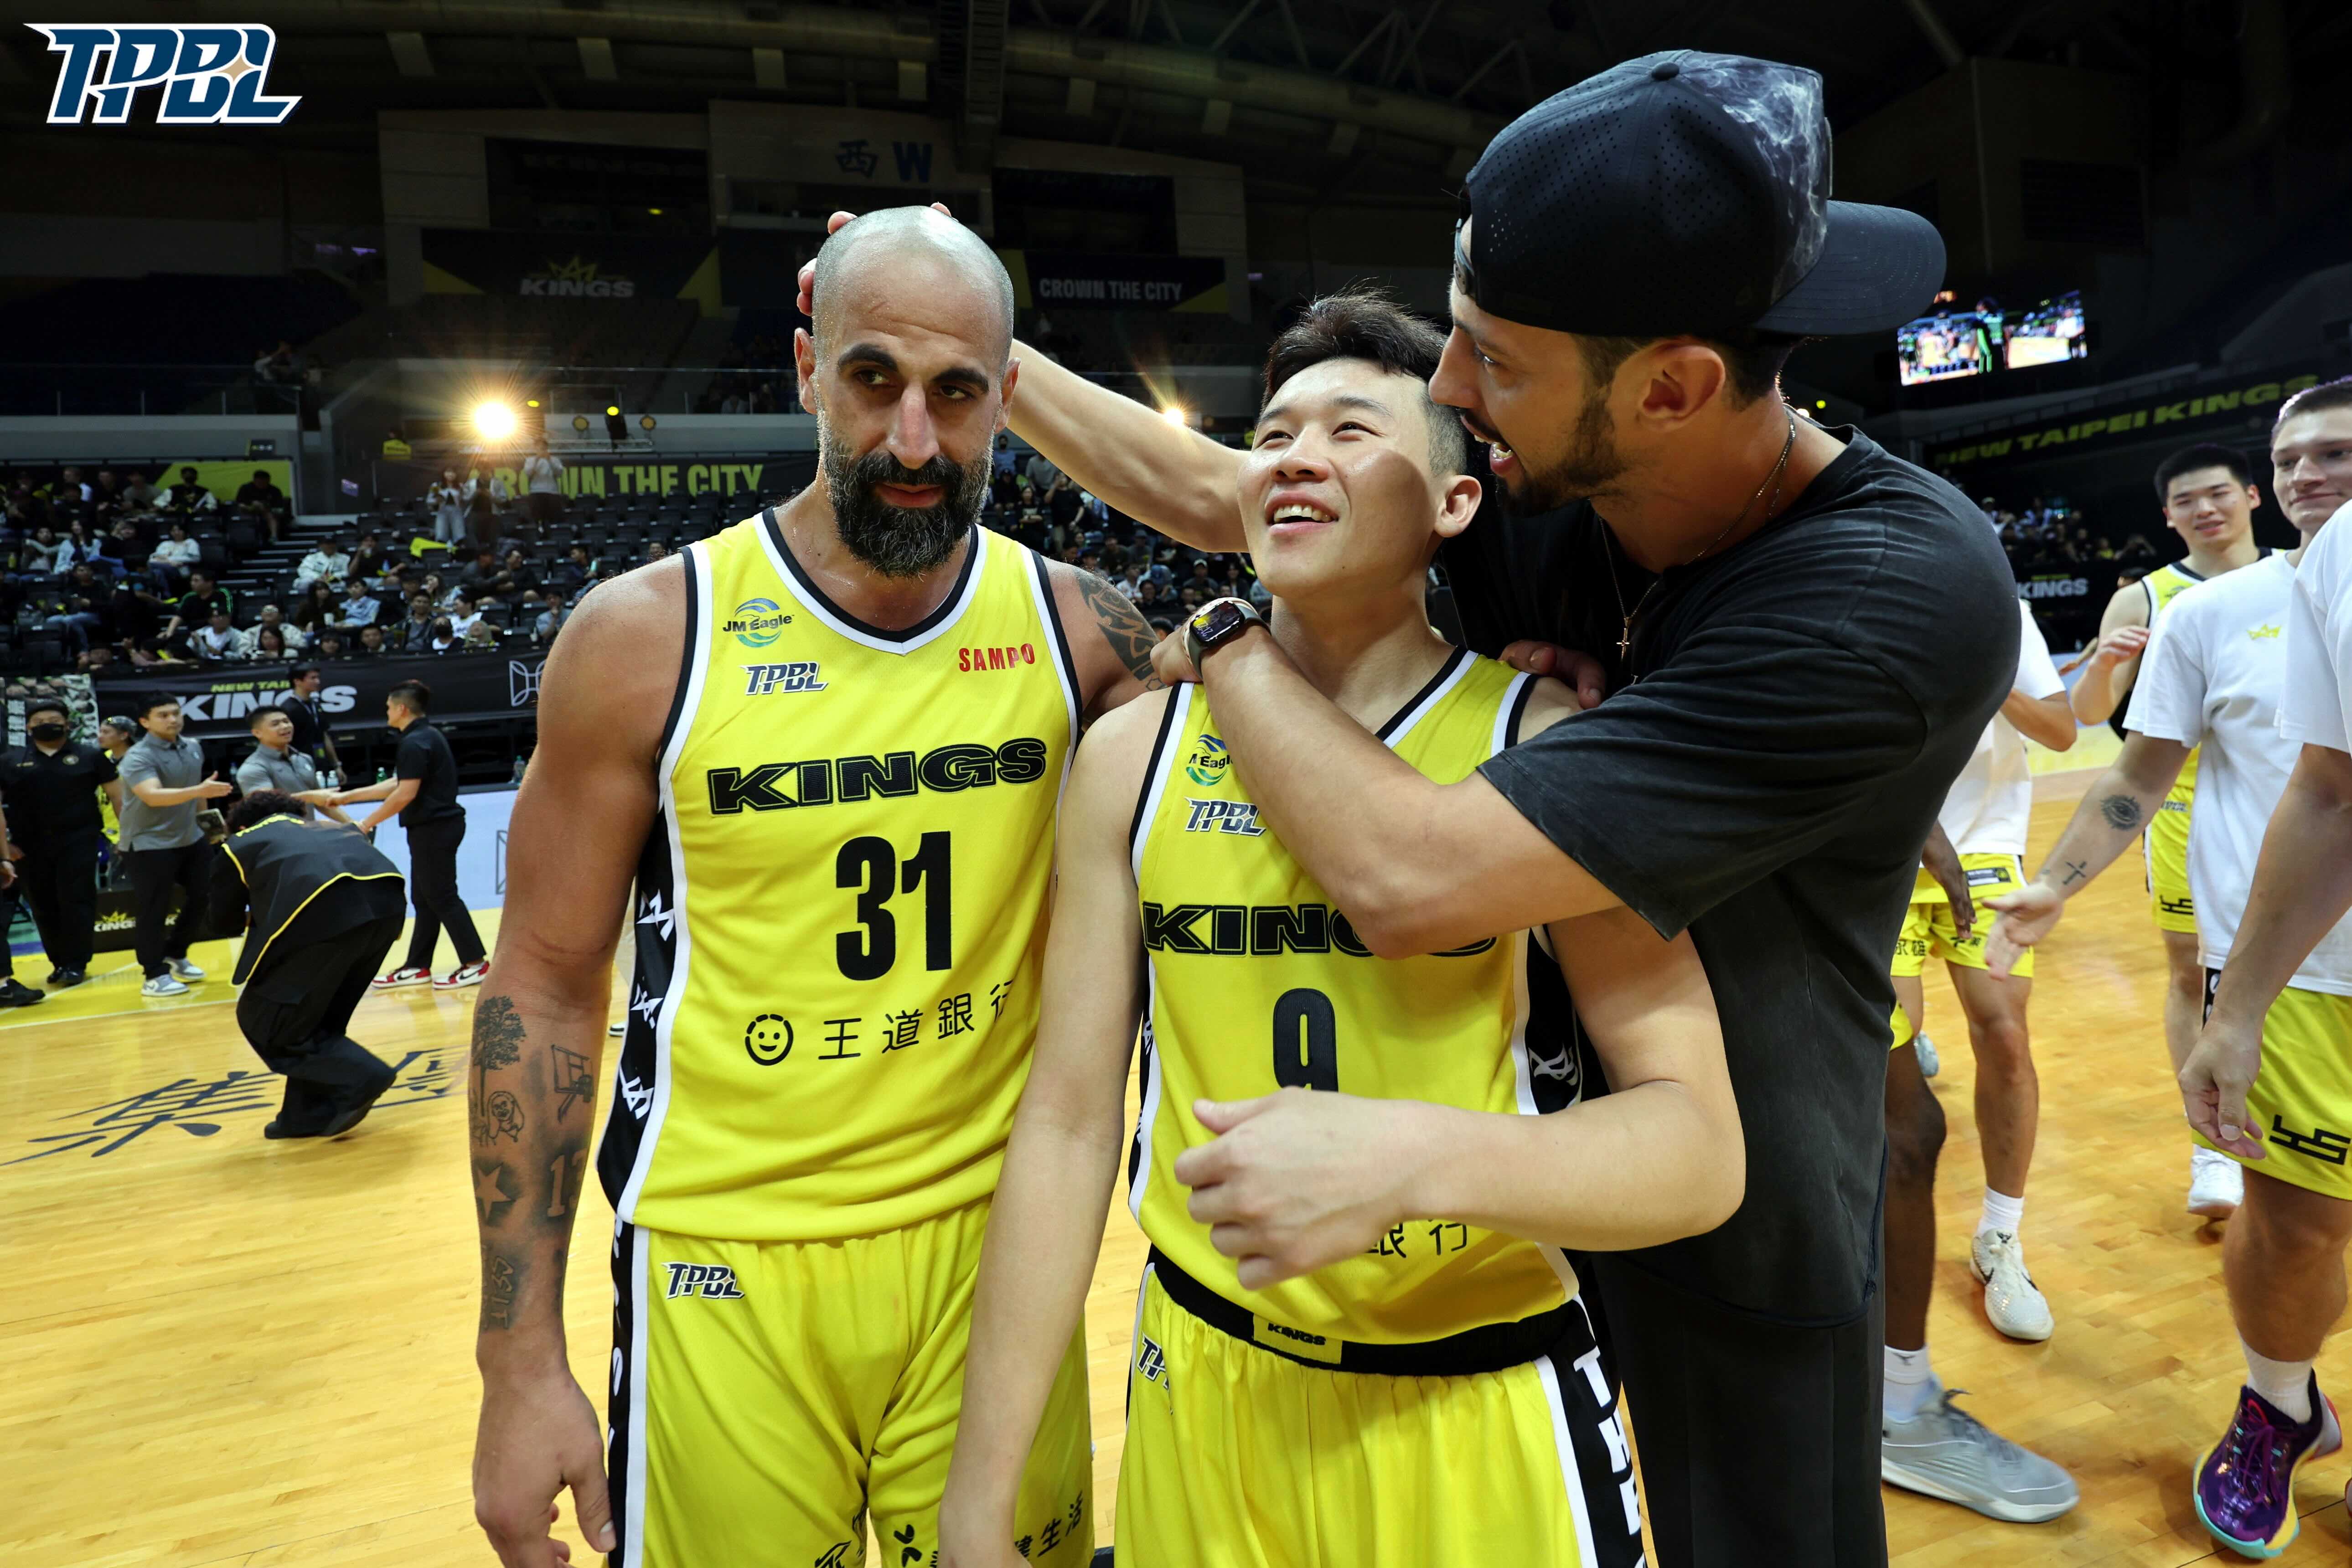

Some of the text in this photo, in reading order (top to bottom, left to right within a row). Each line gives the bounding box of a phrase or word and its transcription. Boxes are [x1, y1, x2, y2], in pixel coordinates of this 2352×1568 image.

[836, 140, 932, 181] 西 W
[520, 279, 635, 297] KINGS
[1039, 279, 1184, 301] CROWN THE CITY
[1934, 374, 2321, 468] NEW TAIPEI KINGS
[687, 464, 763, 497] CITY
[2017, 576, 2089, 599] KINGS
[723, 614, 793, 632] JM Eagle
[960, 643, 1035, 672] SAMPO
[739, 661, 828, 695] TPBL
[707, 737, 1047, 816] KINGS
[1200, 755, 1233, 769] Eagl
[1184, 797, 1266, 836] TPBL
[835, 831, 952, 981] 31
[1142, 901, 1497, 957] KIN
[661, 1261, 744, 1300] TPBL
